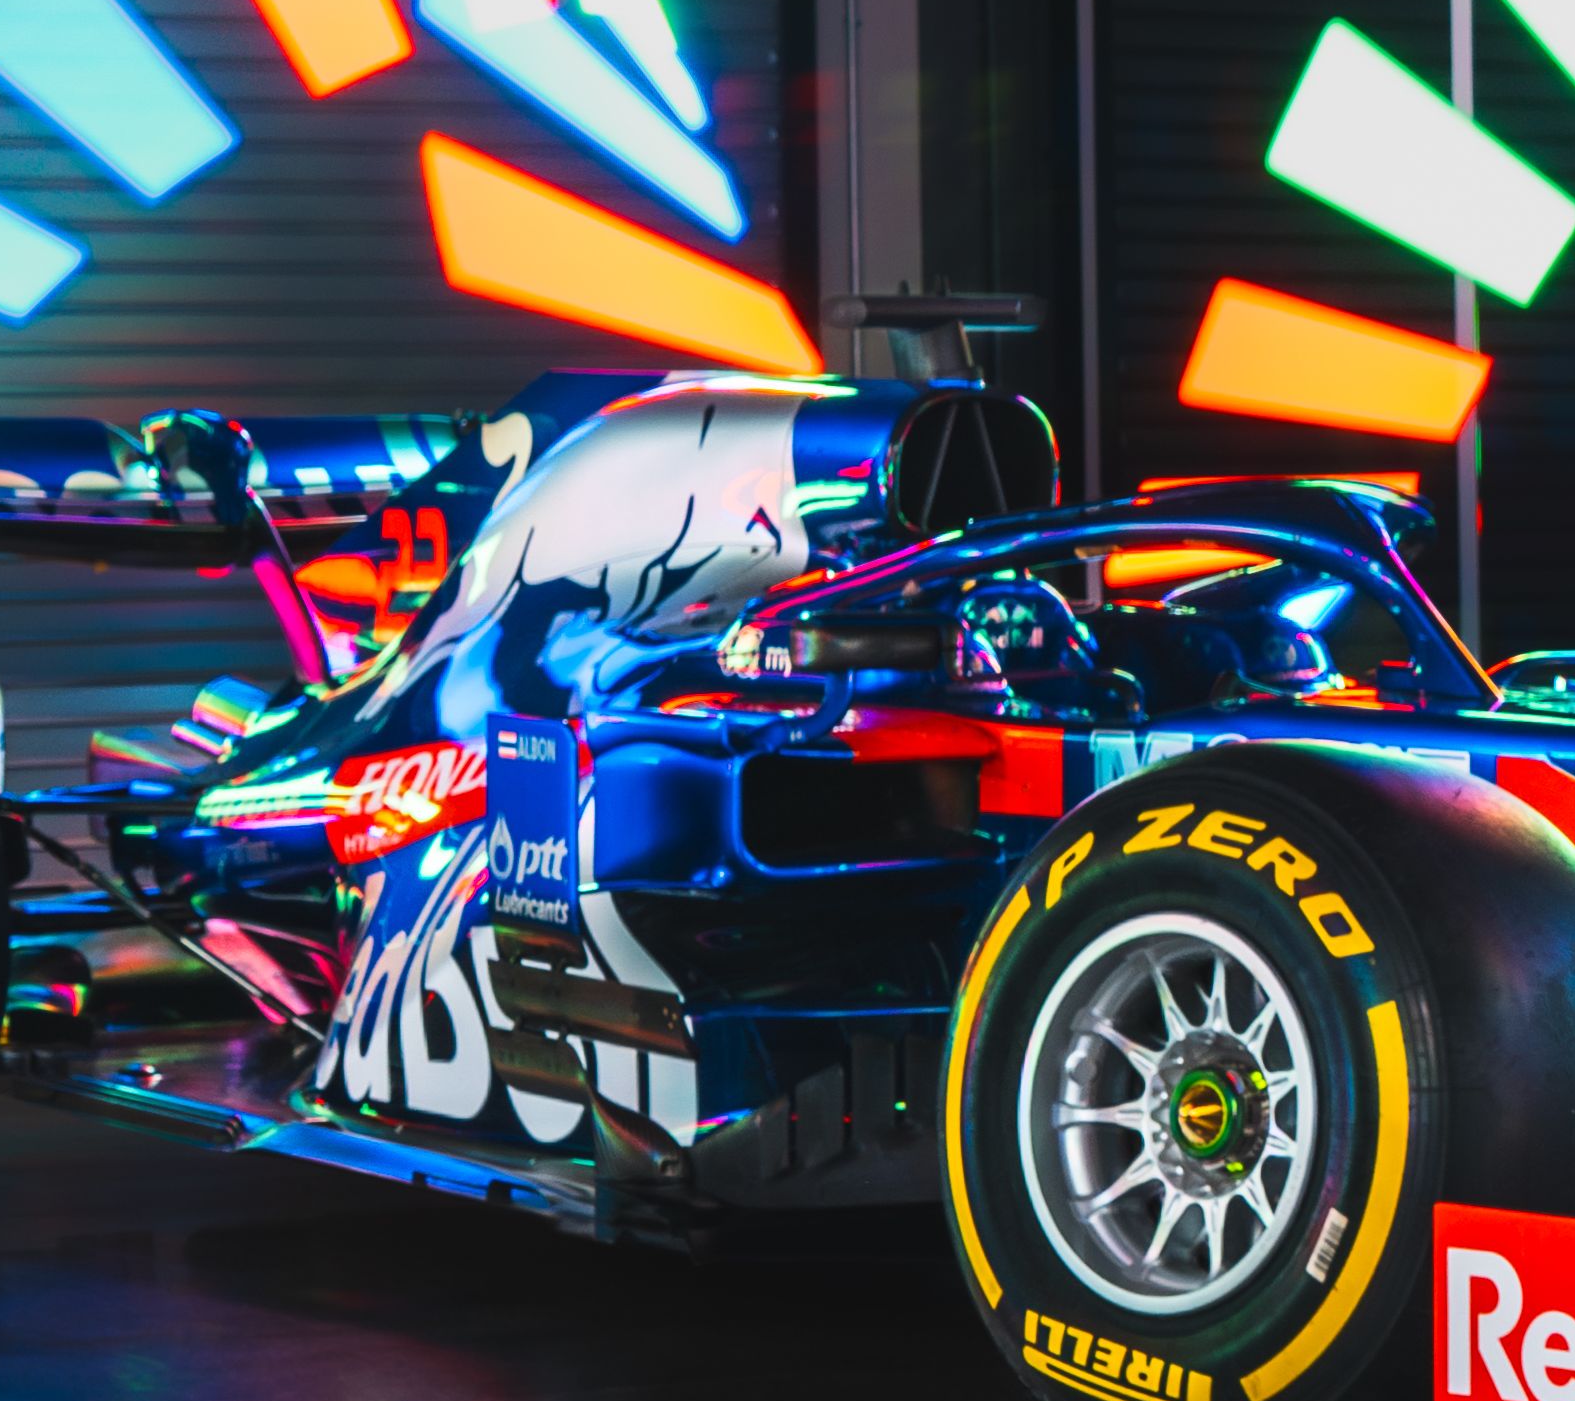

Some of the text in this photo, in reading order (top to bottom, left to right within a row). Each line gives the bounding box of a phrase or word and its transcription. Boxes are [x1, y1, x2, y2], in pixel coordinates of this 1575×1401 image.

[518, 735, 556, 763] ALBON
[516, 835, 568, 883] ptt
[1045, 802, 1376, 959] P ZERO
[495, 886, 570, 925] Lubricants
